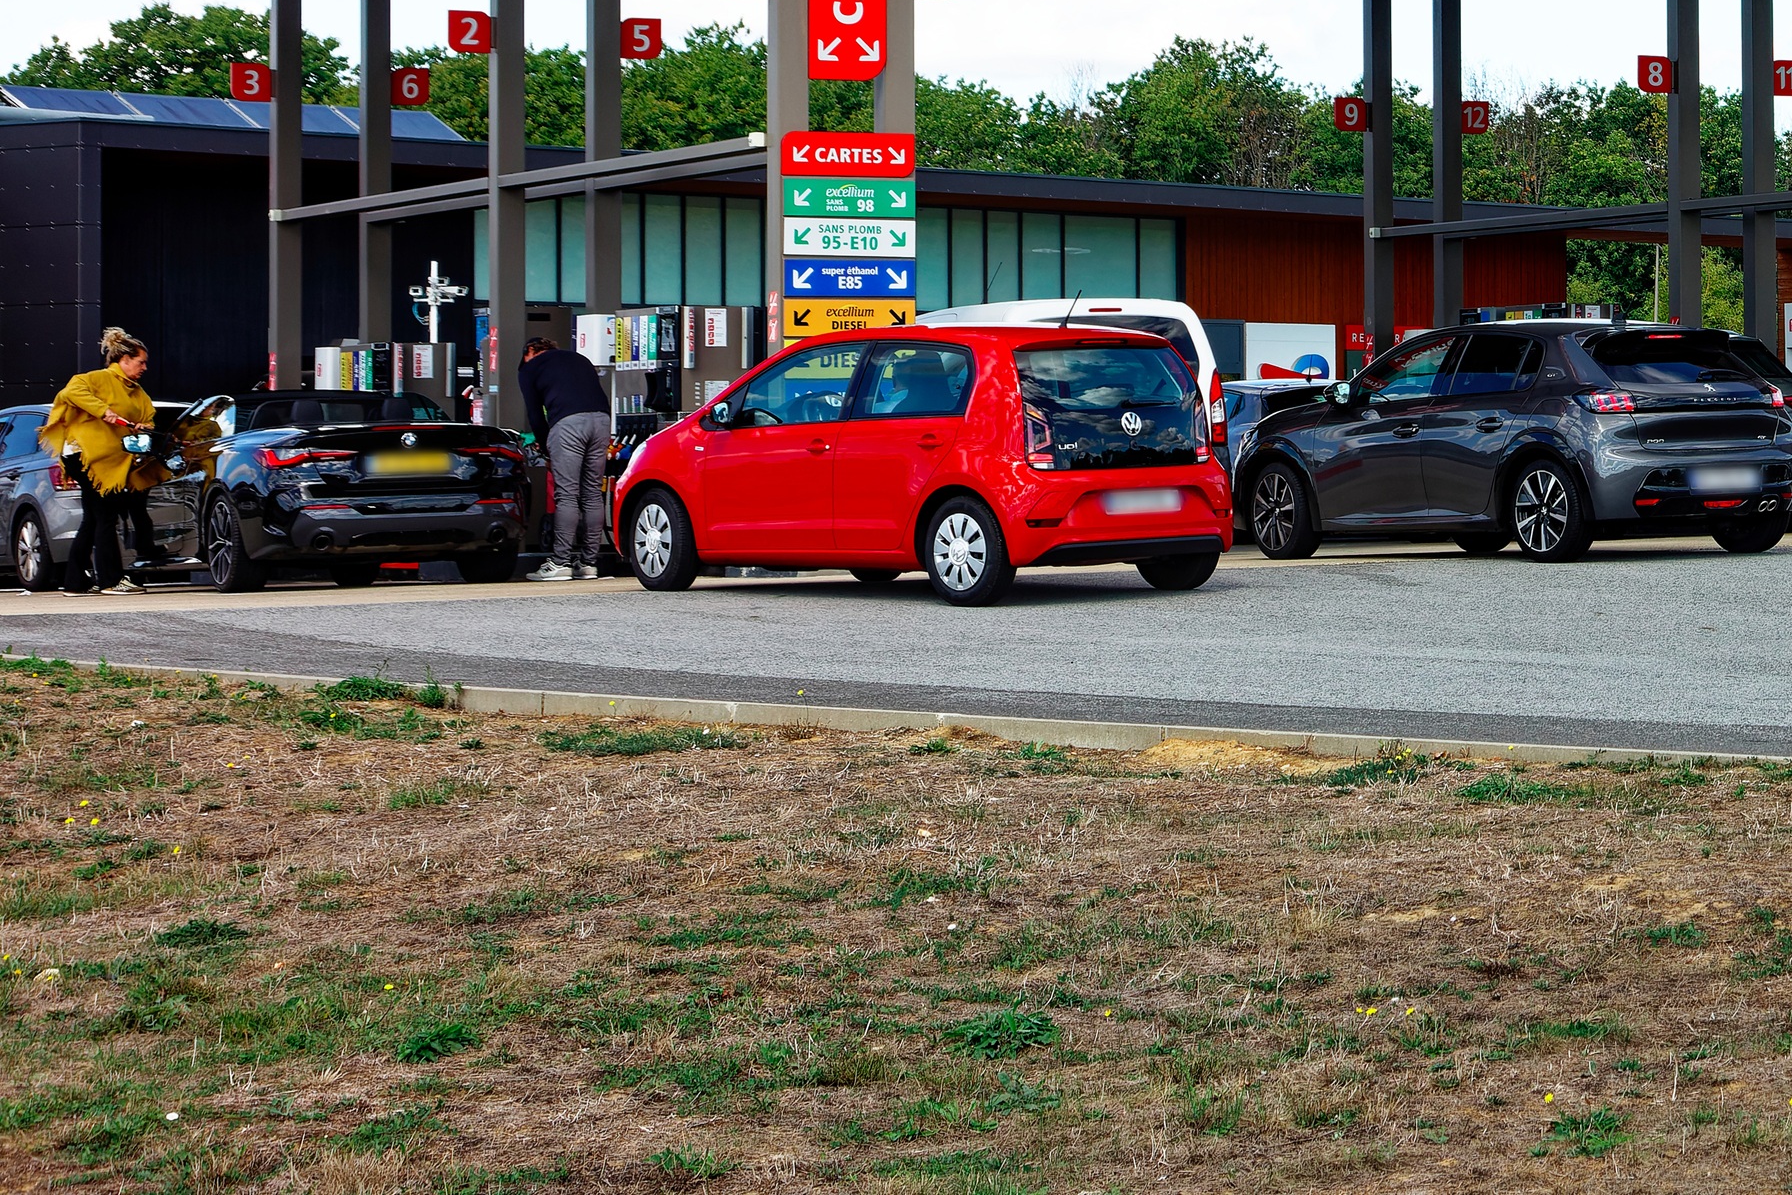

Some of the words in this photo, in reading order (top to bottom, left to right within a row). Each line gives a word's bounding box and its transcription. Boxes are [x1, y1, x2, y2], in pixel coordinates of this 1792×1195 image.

[459, 17, 479, 46] 2
[632, 24, 651, 53] 5
[1648, 62, 1663, 86] 8
[243, 70, 261, 96] 3
[402, 73, 419, 100] 6
[1344, 103, 1359, 126] 9
[1463, 106, 1484, 128] 12
[814, 147, 883, 164] CARTES
[825, 185, 875, 198] excellium
[857, 199, 874, 212] 98
[818, 224, 845, 234] SANS
[848, 225, 882, 235] PLOMB
[821, 236, 879, 250] 95-E10
[821, 267, 845, 276] super
[847, 266, 878, 275] éthanol
[838, 276, 862, 290] E85
[826, 306, 874, 317] excellium
